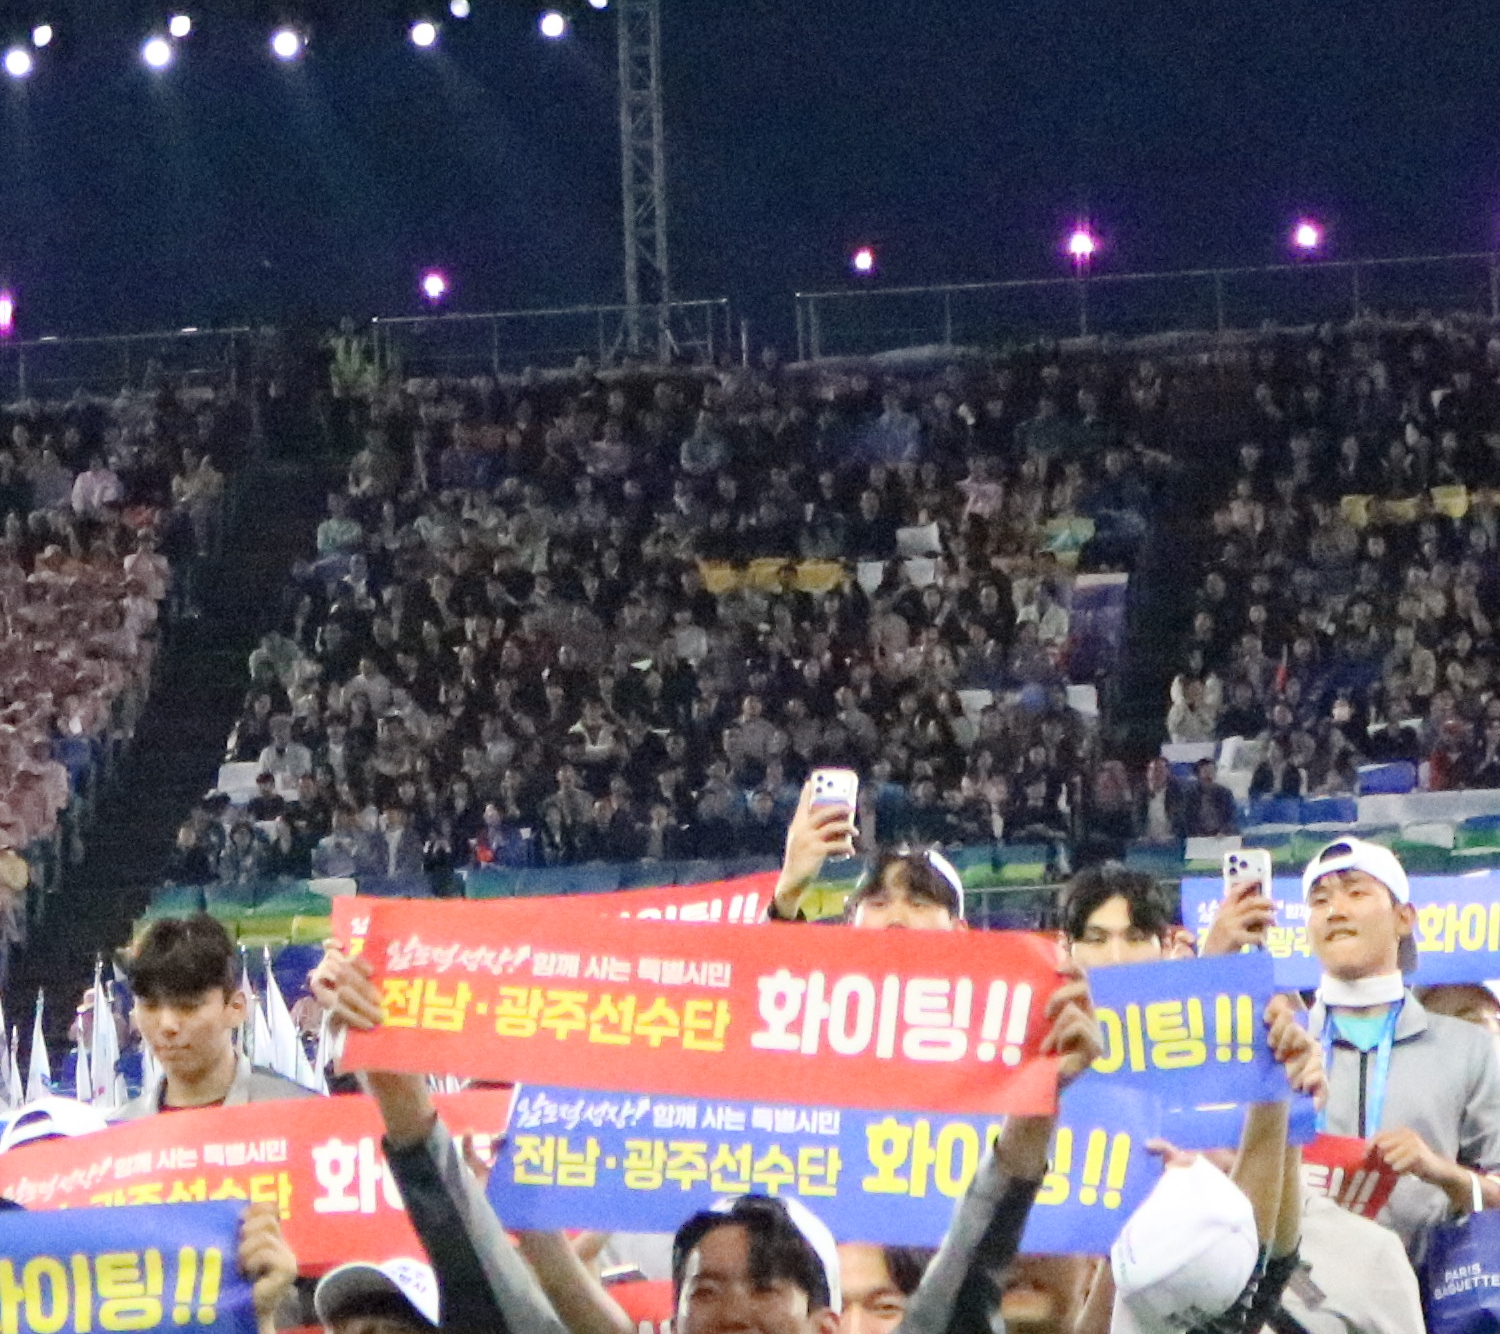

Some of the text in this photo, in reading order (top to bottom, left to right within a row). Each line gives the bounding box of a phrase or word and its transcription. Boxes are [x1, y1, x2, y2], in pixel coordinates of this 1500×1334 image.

[532, 951, 582, 979] 함께
[584, 955, 632, 983] 사는
[637, 955, 733, 989] 특별시민
[381, 967, 1034, 1067] 전남·광주선수단 화이팅!!
[652, 1102, 698, 1129] 함께
[701, 1105, 746, 1131] 사는
[751, 1107, 841, 1136] 특별시민
[512, 1135, 843, 1198] 전남·광주선수단
[1445, 1262, 1481, 1283] PARIS
